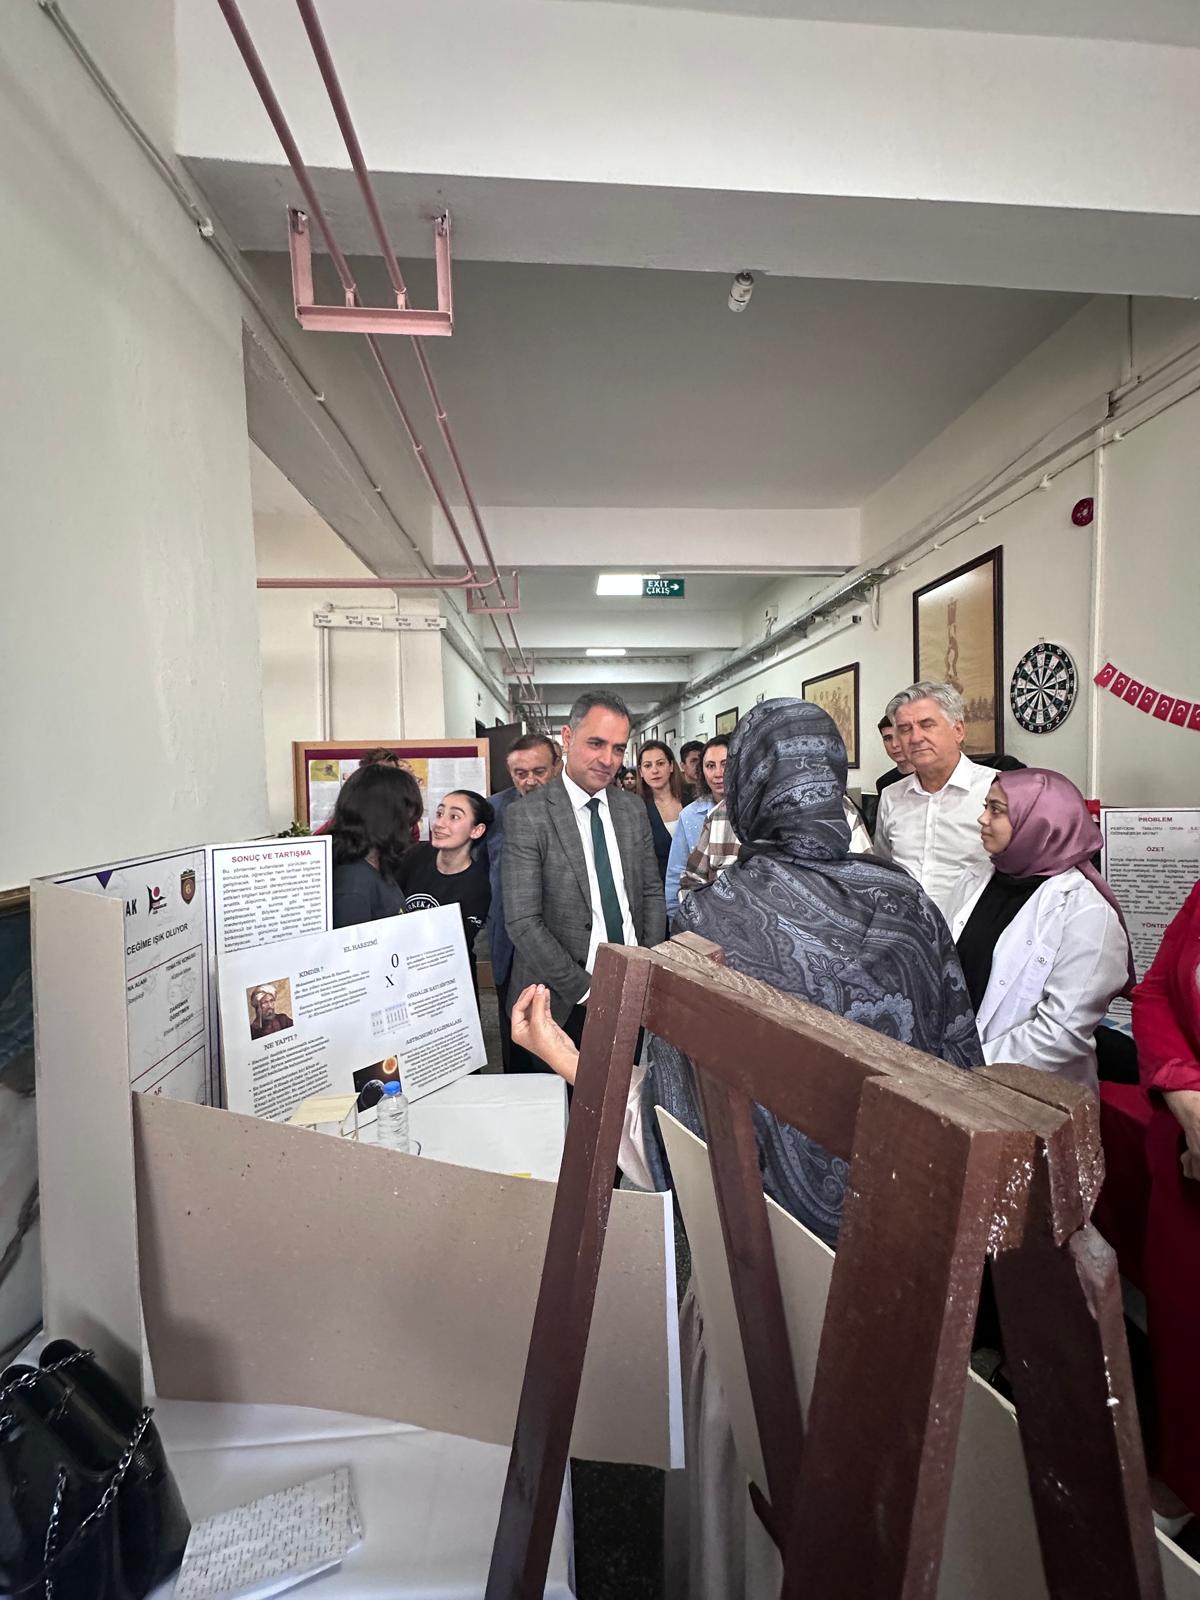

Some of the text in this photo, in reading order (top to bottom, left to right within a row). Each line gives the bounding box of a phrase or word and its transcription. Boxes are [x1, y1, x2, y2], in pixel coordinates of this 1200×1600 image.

[646, 587, 670, 595] ÇIKIŞ
[231, 850, 311, 863] SONUÇ VE TARTIŞMA
[166, 923, 188, 939] OLUYOR
[275, 1036, 294, 1046] YAPTI
